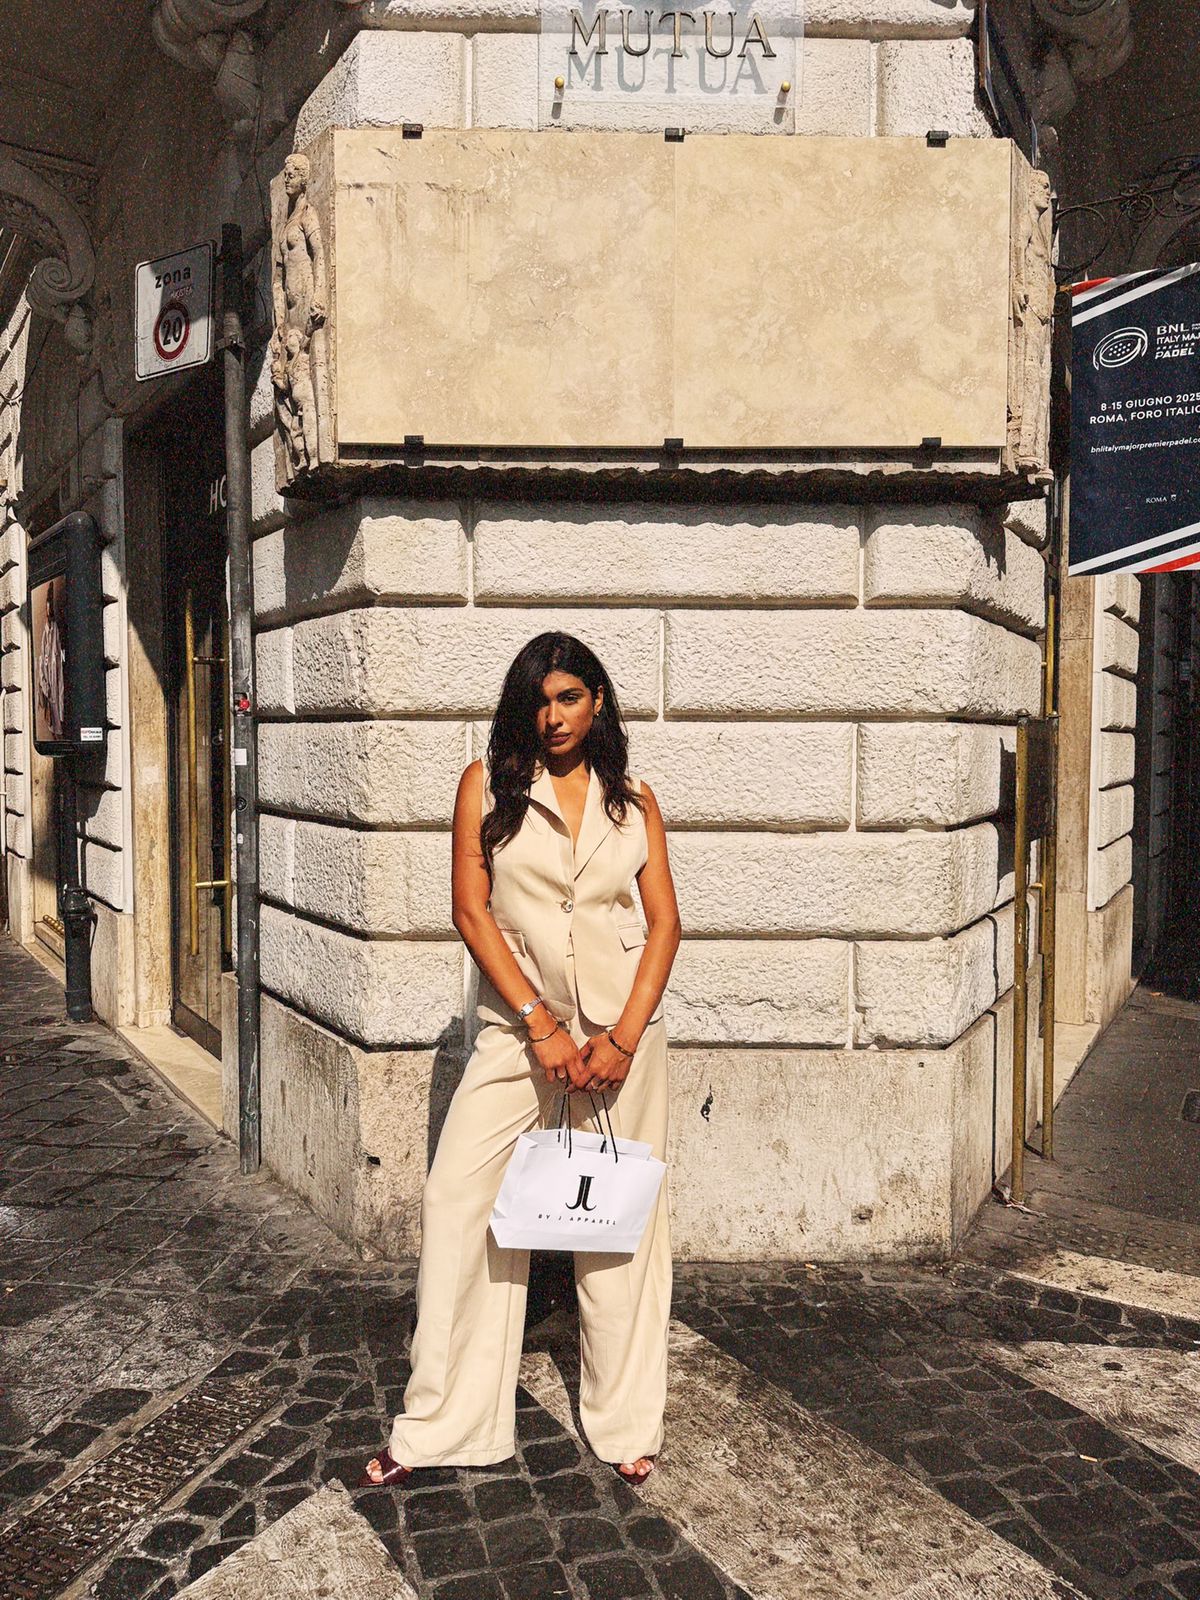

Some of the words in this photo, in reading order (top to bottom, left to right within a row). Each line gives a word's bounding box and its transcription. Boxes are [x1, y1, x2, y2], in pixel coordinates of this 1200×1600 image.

[569, 8, 777, 58] MUTUA
[155, 266, 191, 288] zona
[163, 316, 182, 345] 20
[1157, 323, 1189, 335] BNL
[1156, 335, 1181, 344] ITALY
[1155, 348, 1195, 359] PADEL
[1100, 401, 1122, 411] 8-15
[1125, 396, 1172, 409] GIUGNO
[1176, 392, 1200, 403] 2025
[1090, 414, 1127, 424] ROMA,
[1131, 409, 1162, 420] FORO
[1145, 496, 1168, 504] ROMA
[570, 1217, 616, 1225] APPAREL
